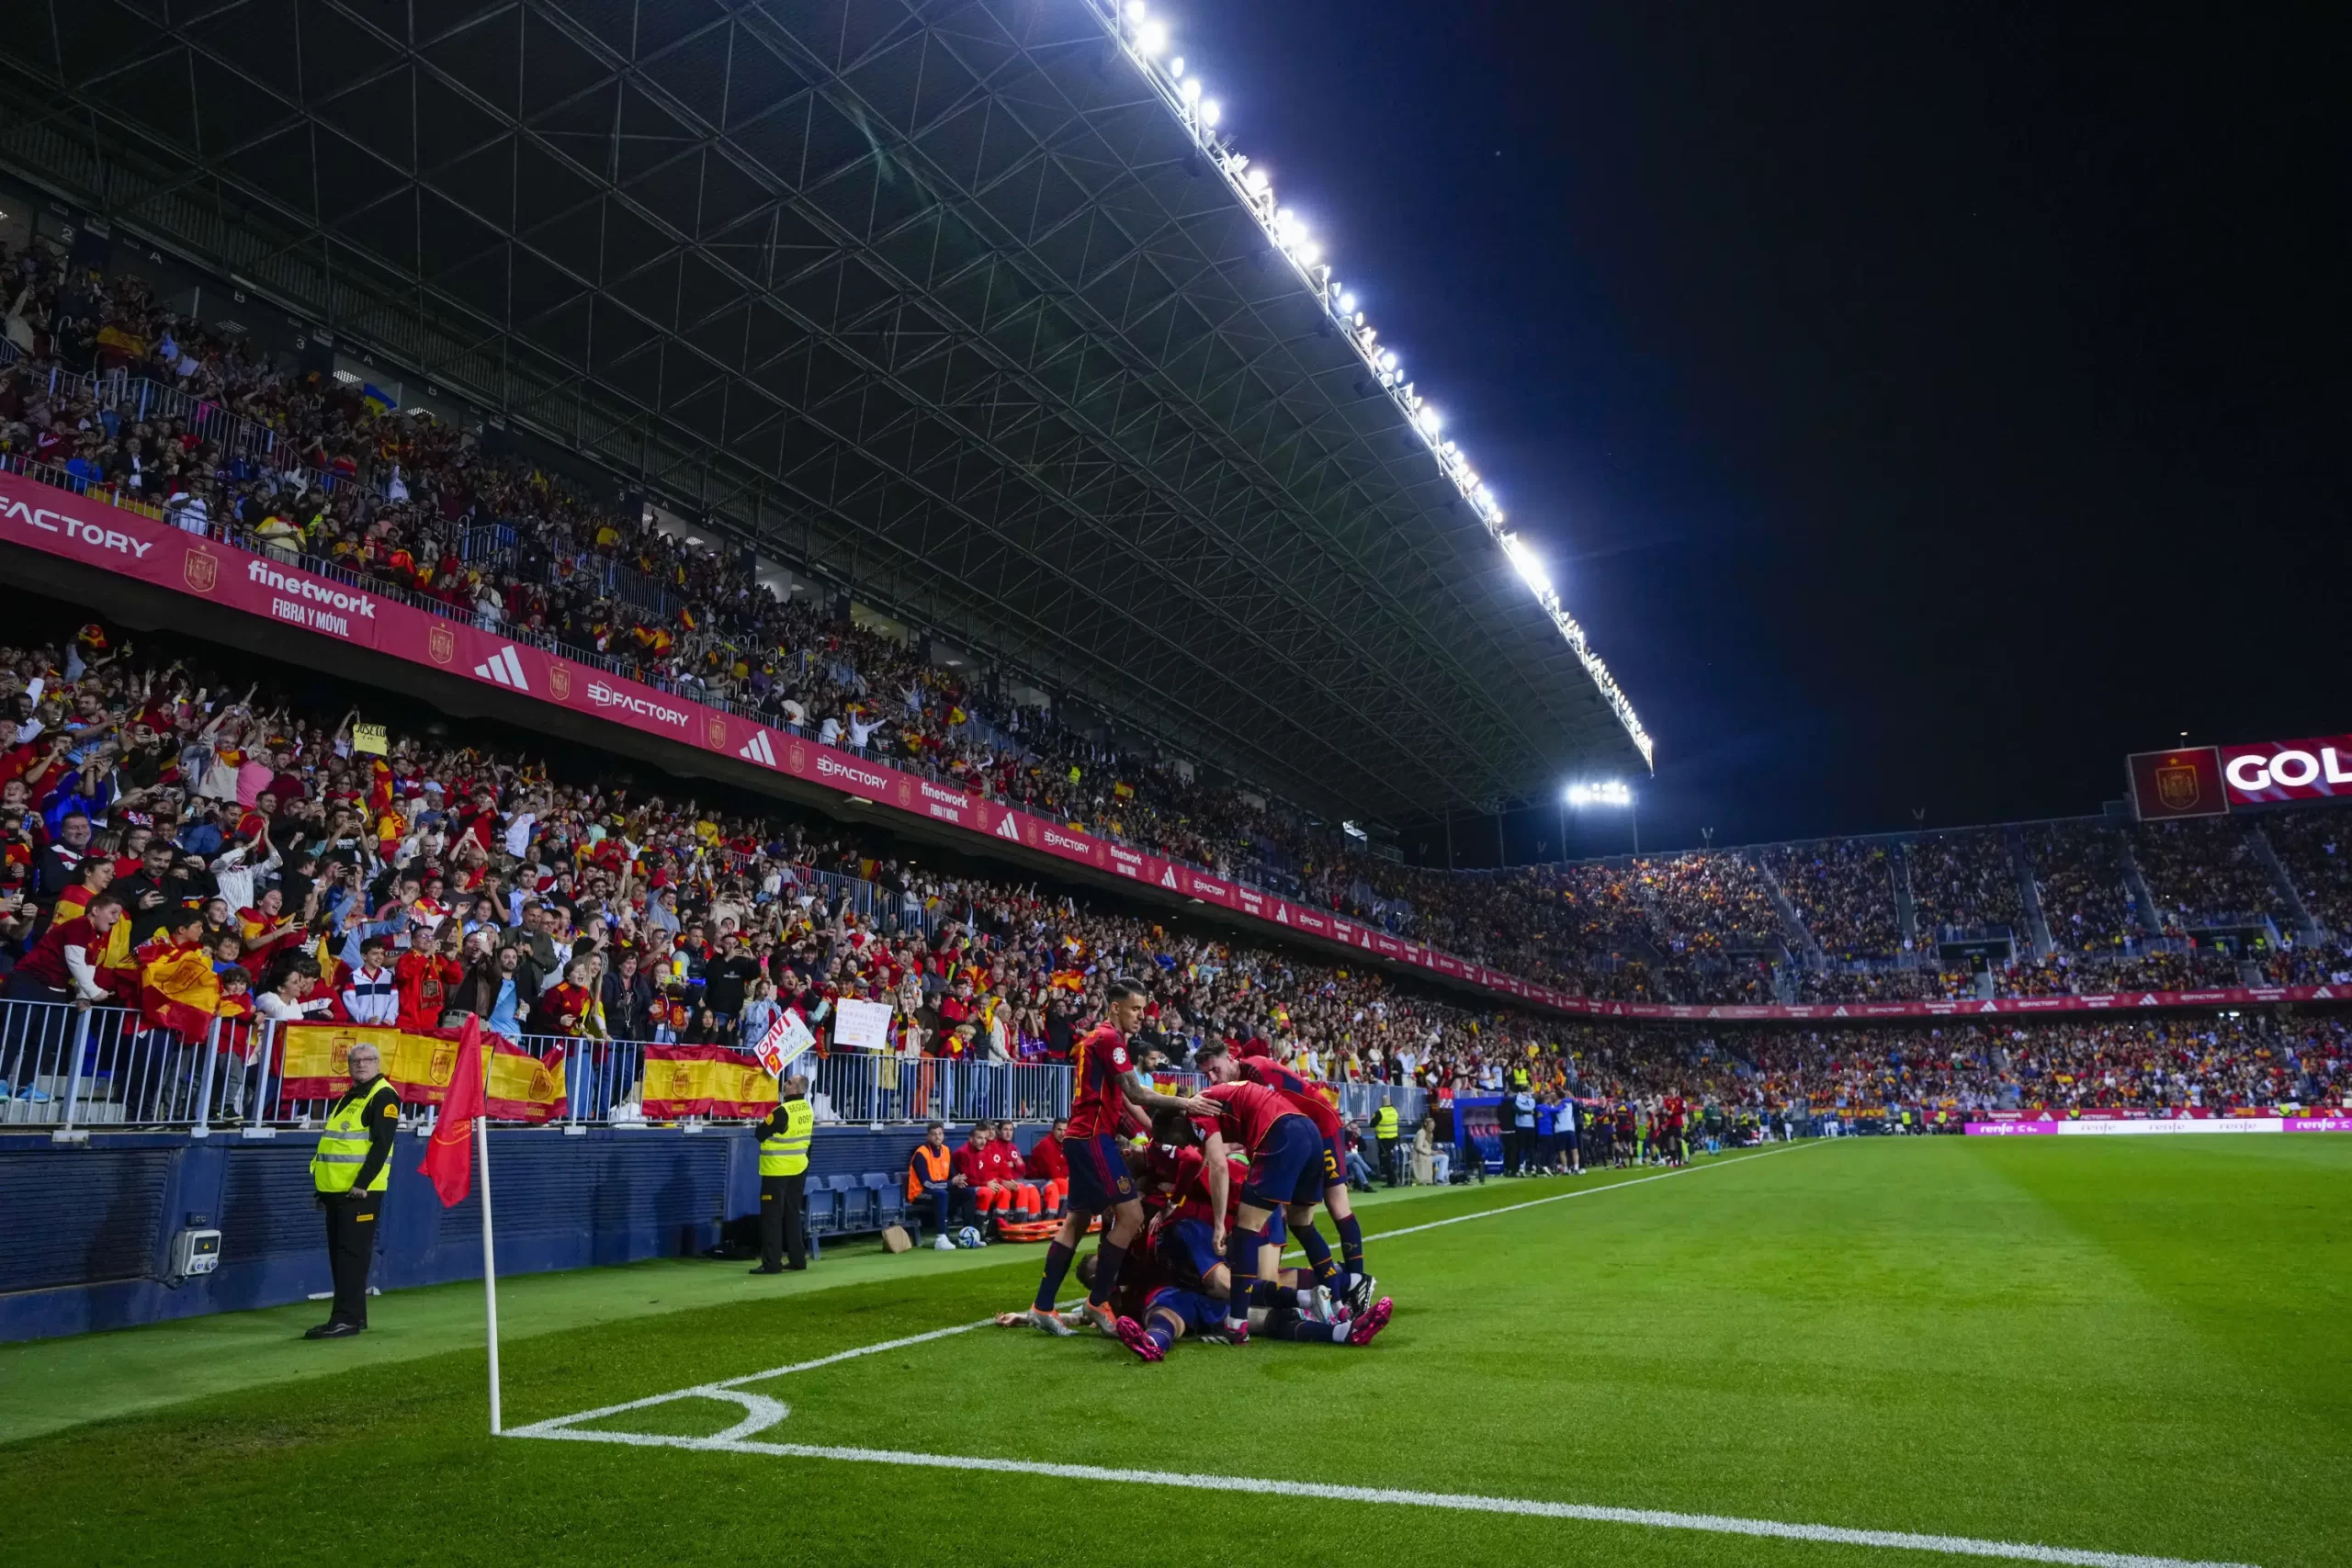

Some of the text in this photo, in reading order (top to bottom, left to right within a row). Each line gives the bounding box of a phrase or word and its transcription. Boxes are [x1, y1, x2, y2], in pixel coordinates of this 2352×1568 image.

[62, 228, 74, 242] 2
[149, 251, 162, 265] A
[234, 290, 246, 303] B
[296, 337, 305, 350] 3
[363, 355, 374, 366] A
[618, 492, 625, 502] 5
[662, 502, 669, 510] A
[248, 560, 376, 618] finetwork
[272, 597, 349, 637] FIBRA Y MÓVIL
[613, 691, 689, 727] FACTORY
[2226, 747, 2352, 791] GOL
[834, 764, 888, 790] FACTORY
[921, 782, 968, 809] finetwork
[1055, 836, 1090, 854] FACTORY
[1110, 845, 1143, 865] finetwork
[758, 1014, 791, 1055] GAVI
[769, 1055, 778, 1073] 9
[1980, 1122, 2014, 1135] renfe
[2081, 1122, 2117, 1134] renfe
[2149, 1122, 2185, 1134] renfe
[2297, 1118, 2336, 1131] renfe
